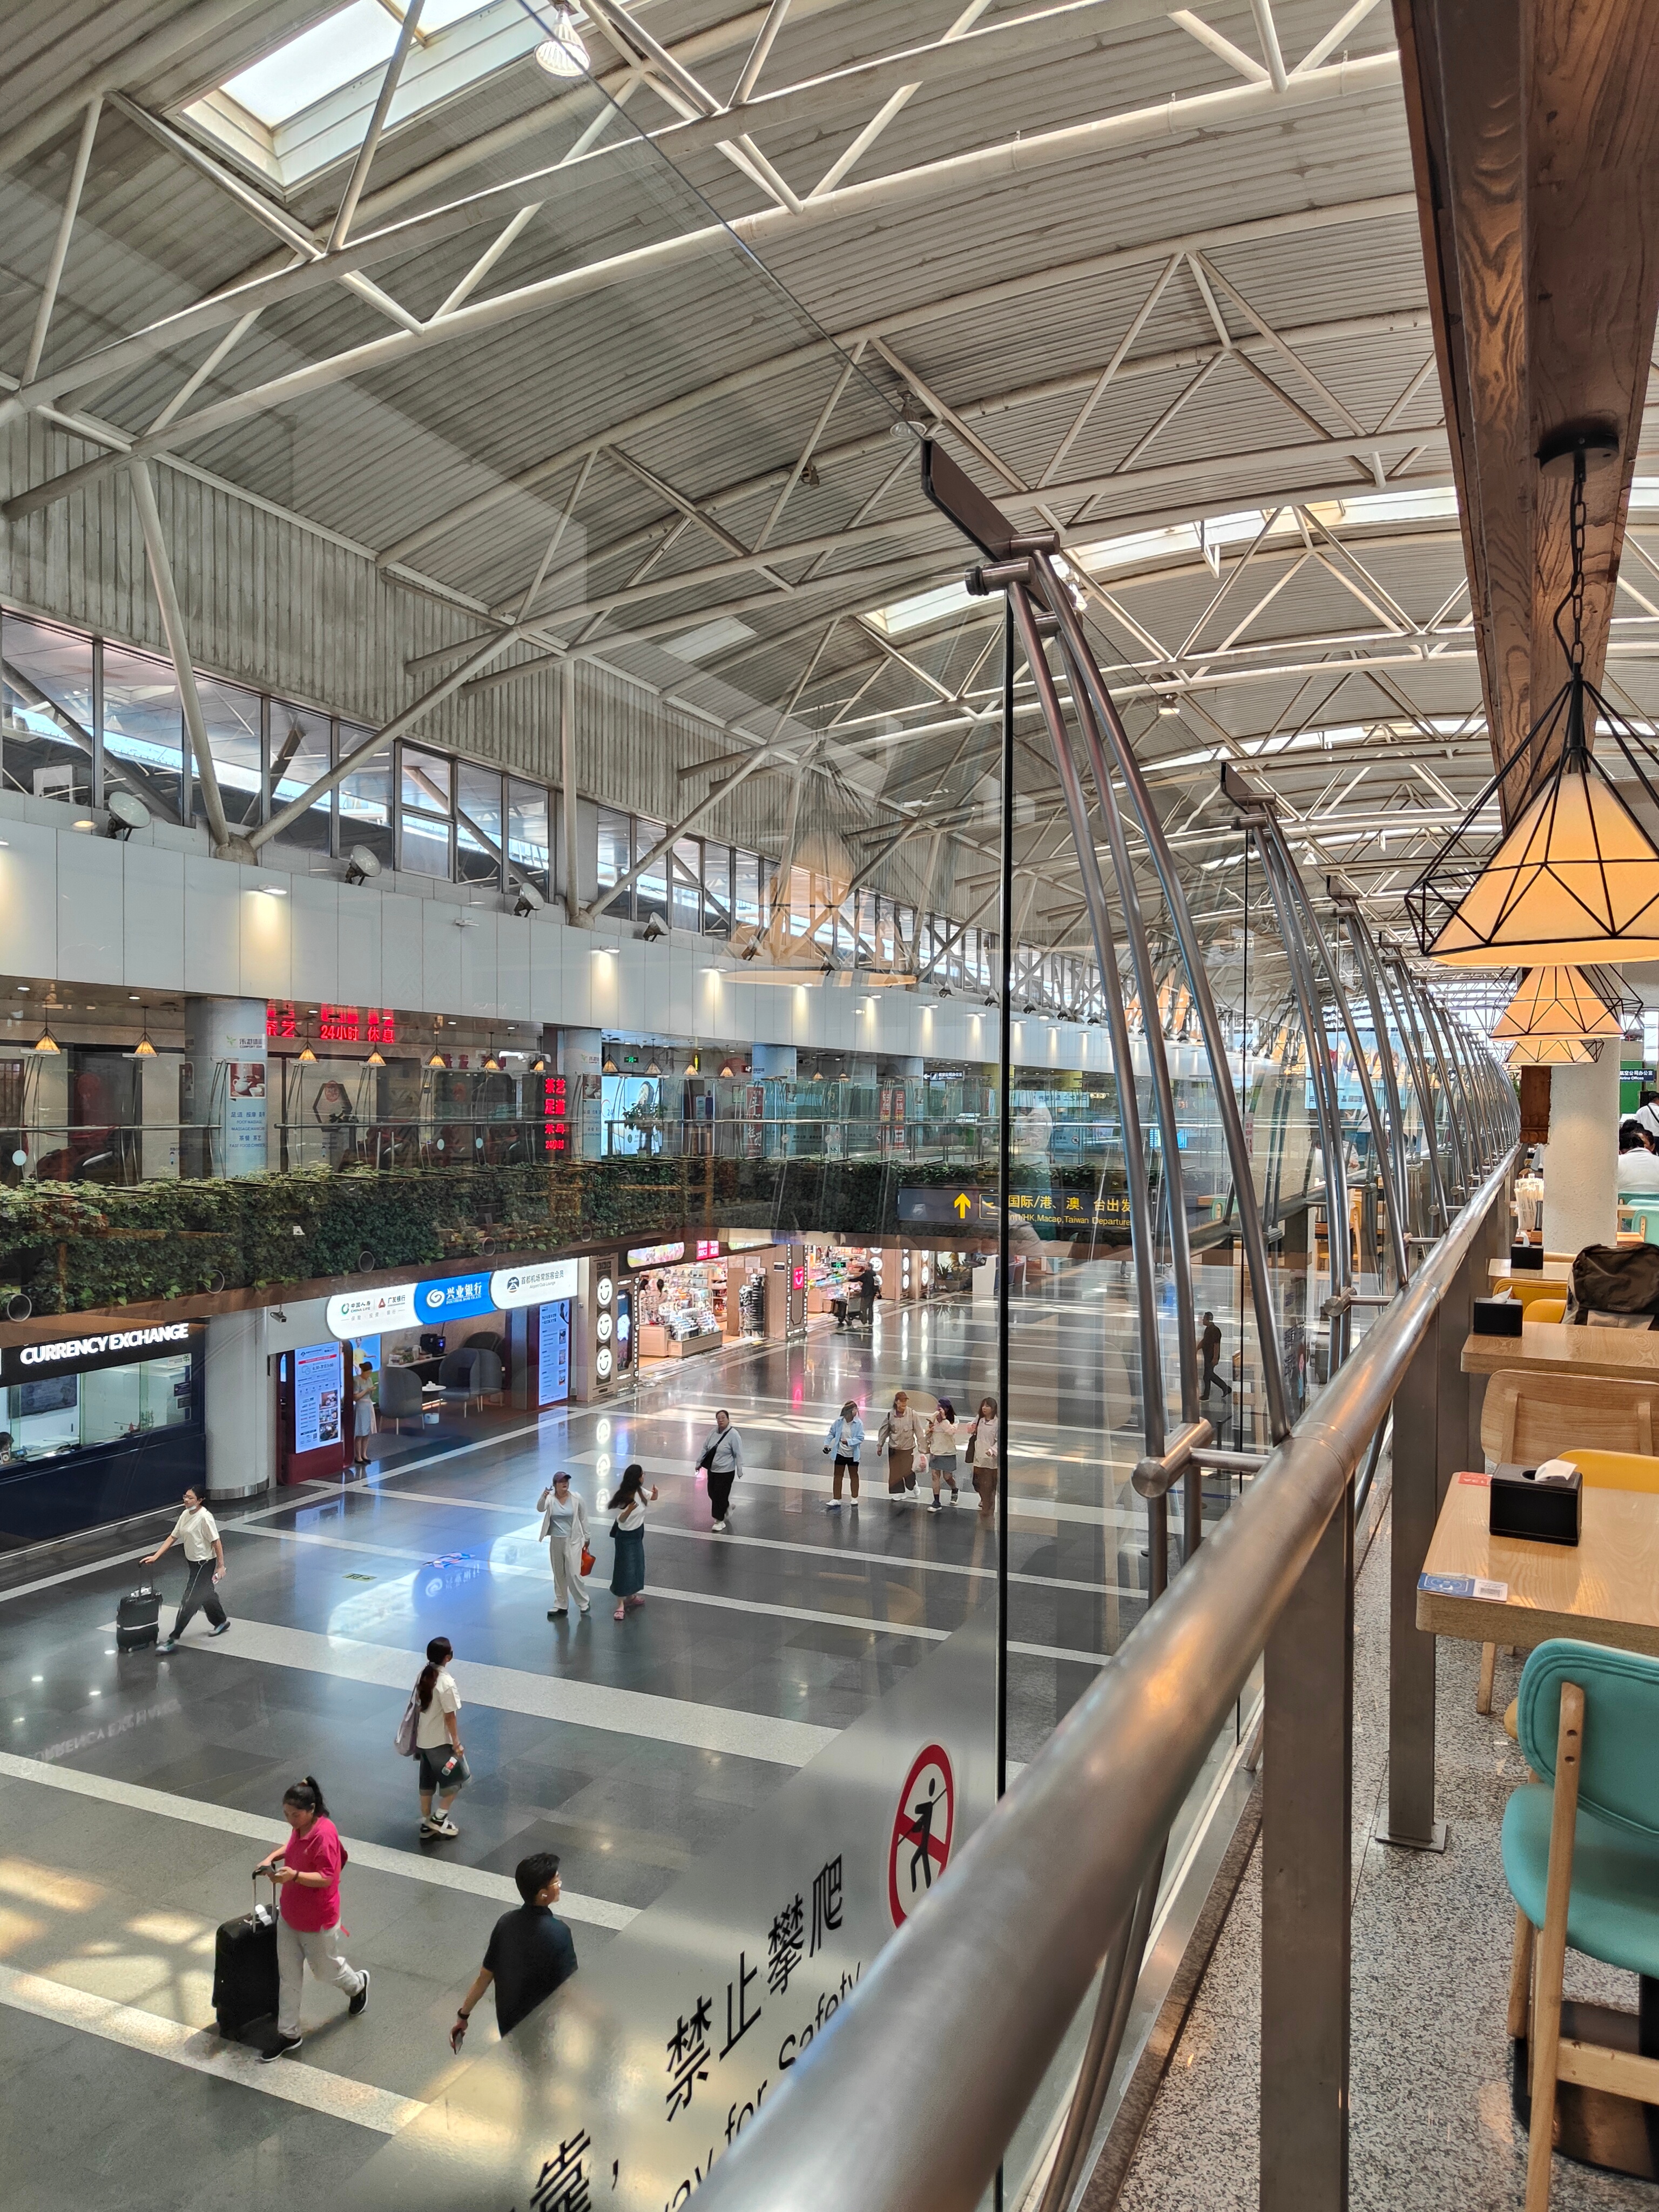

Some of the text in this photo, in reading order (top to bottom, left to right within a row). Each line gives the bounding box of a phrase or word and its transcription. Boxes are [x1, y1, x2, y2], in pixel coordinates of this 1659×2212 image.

[320, 1024, 359, 1041] 24小时
[368, 1027, 394, 1043] 休息
[1092, 1216, 1131, 1226] Departure
[521, 1270, 564, 1285] 首都机场常旅客会员
[446, 1282, 482, 1300] 兴业银行
[388, 1295, 406, 1304] 广发银行
[20, 1323, 189, 1365] CURRENCY EXCHANGE
